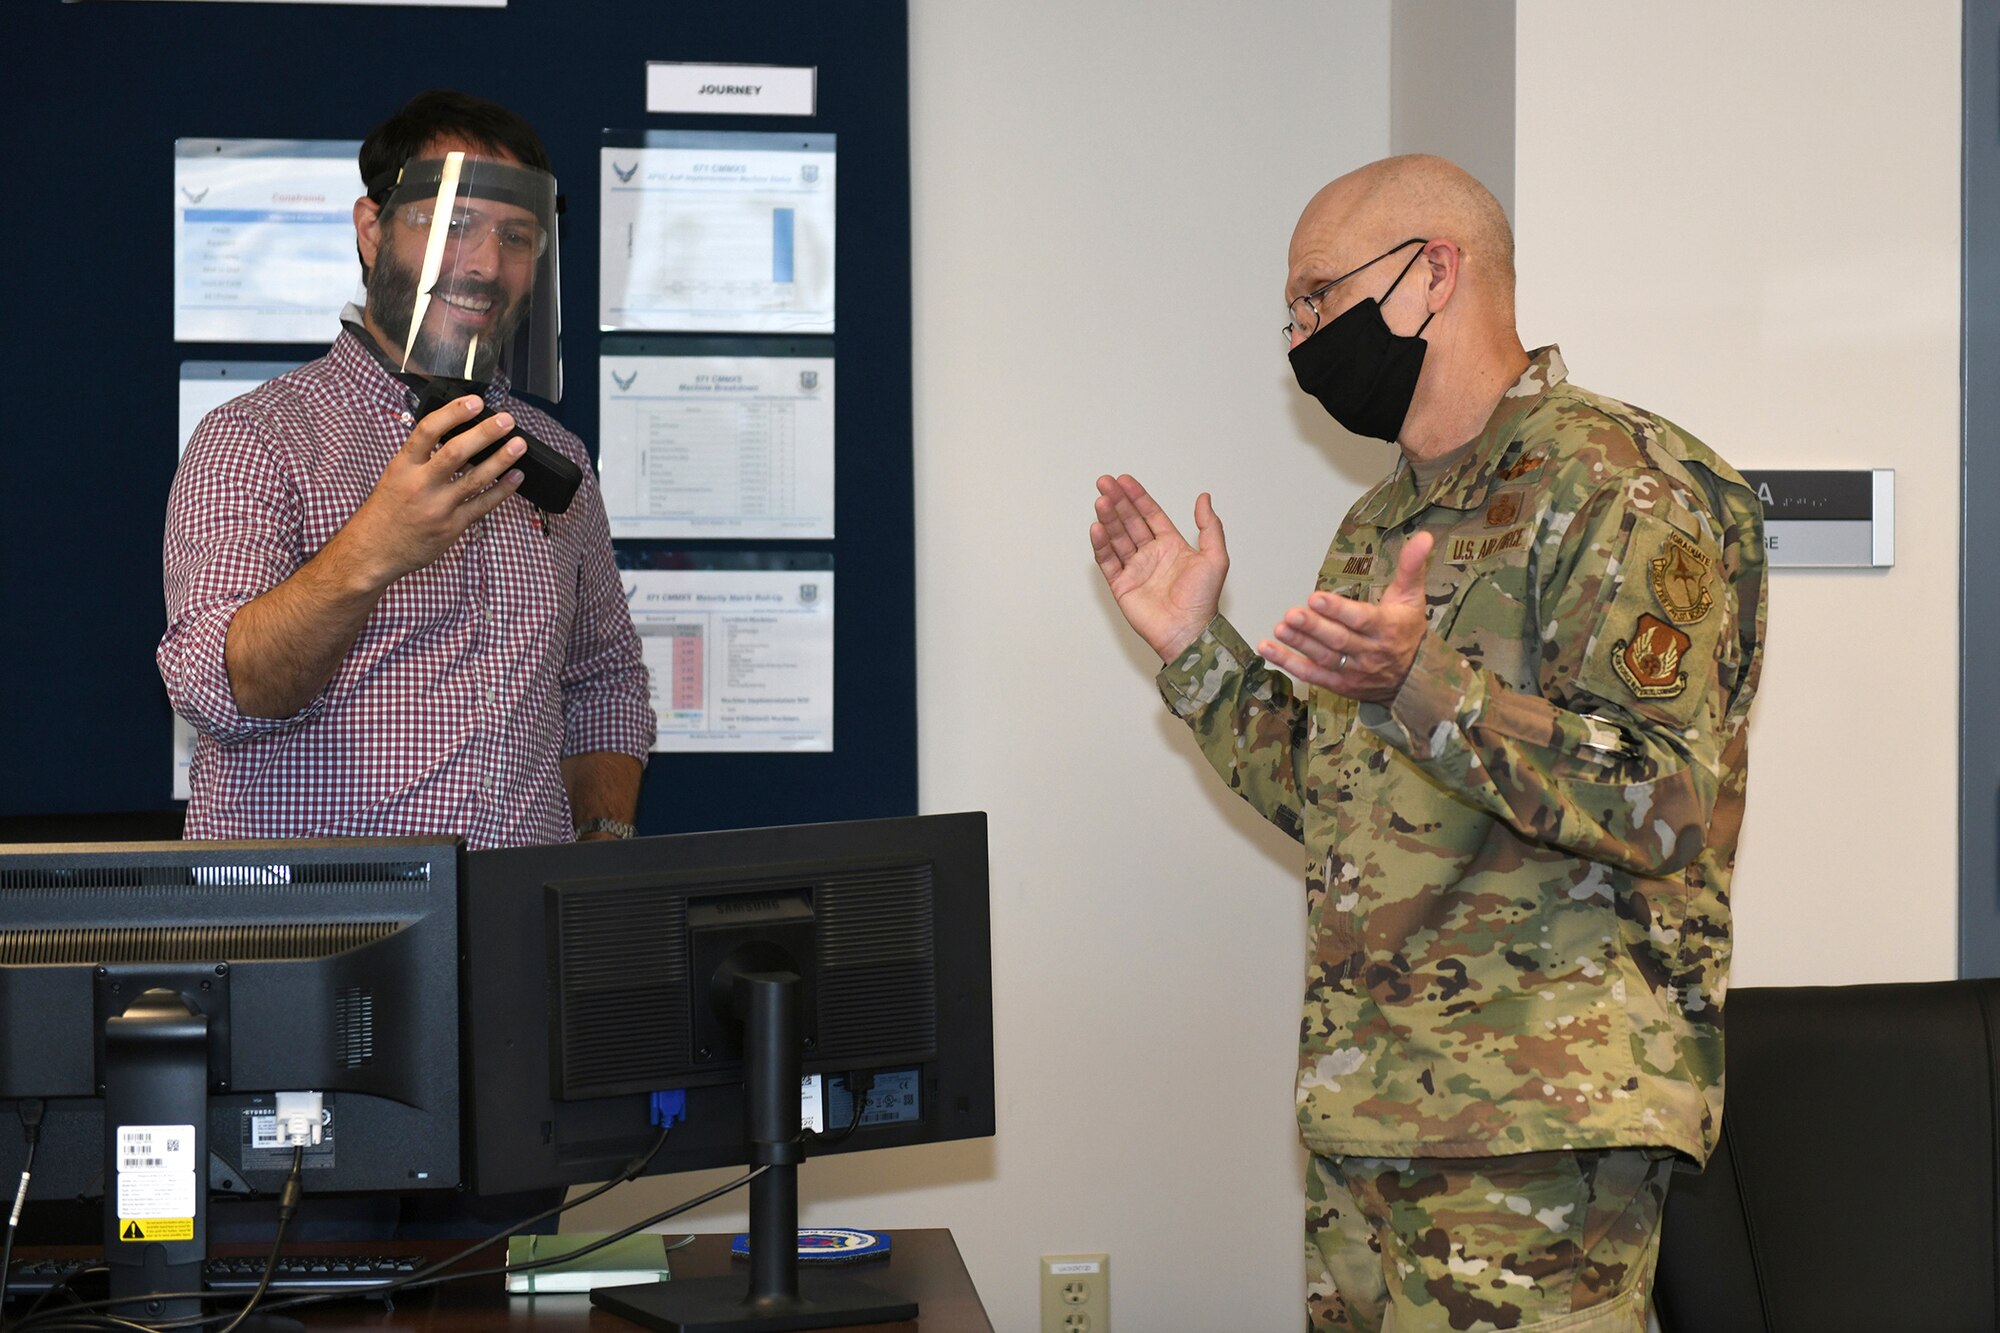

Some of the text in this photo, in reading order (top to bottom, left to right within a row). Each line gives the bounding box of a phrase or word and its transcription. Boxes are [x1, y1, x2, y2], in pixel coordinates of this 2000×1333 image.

[698, 84, 762, 96] JOURNEY
[1453, 539, 1475, 561] U.S.
[1477, 538, 1497, 560] AIR
[1671, 532, 1712, 567] GRADUATE
[715, 900, 781, 915] SAMSUNG
